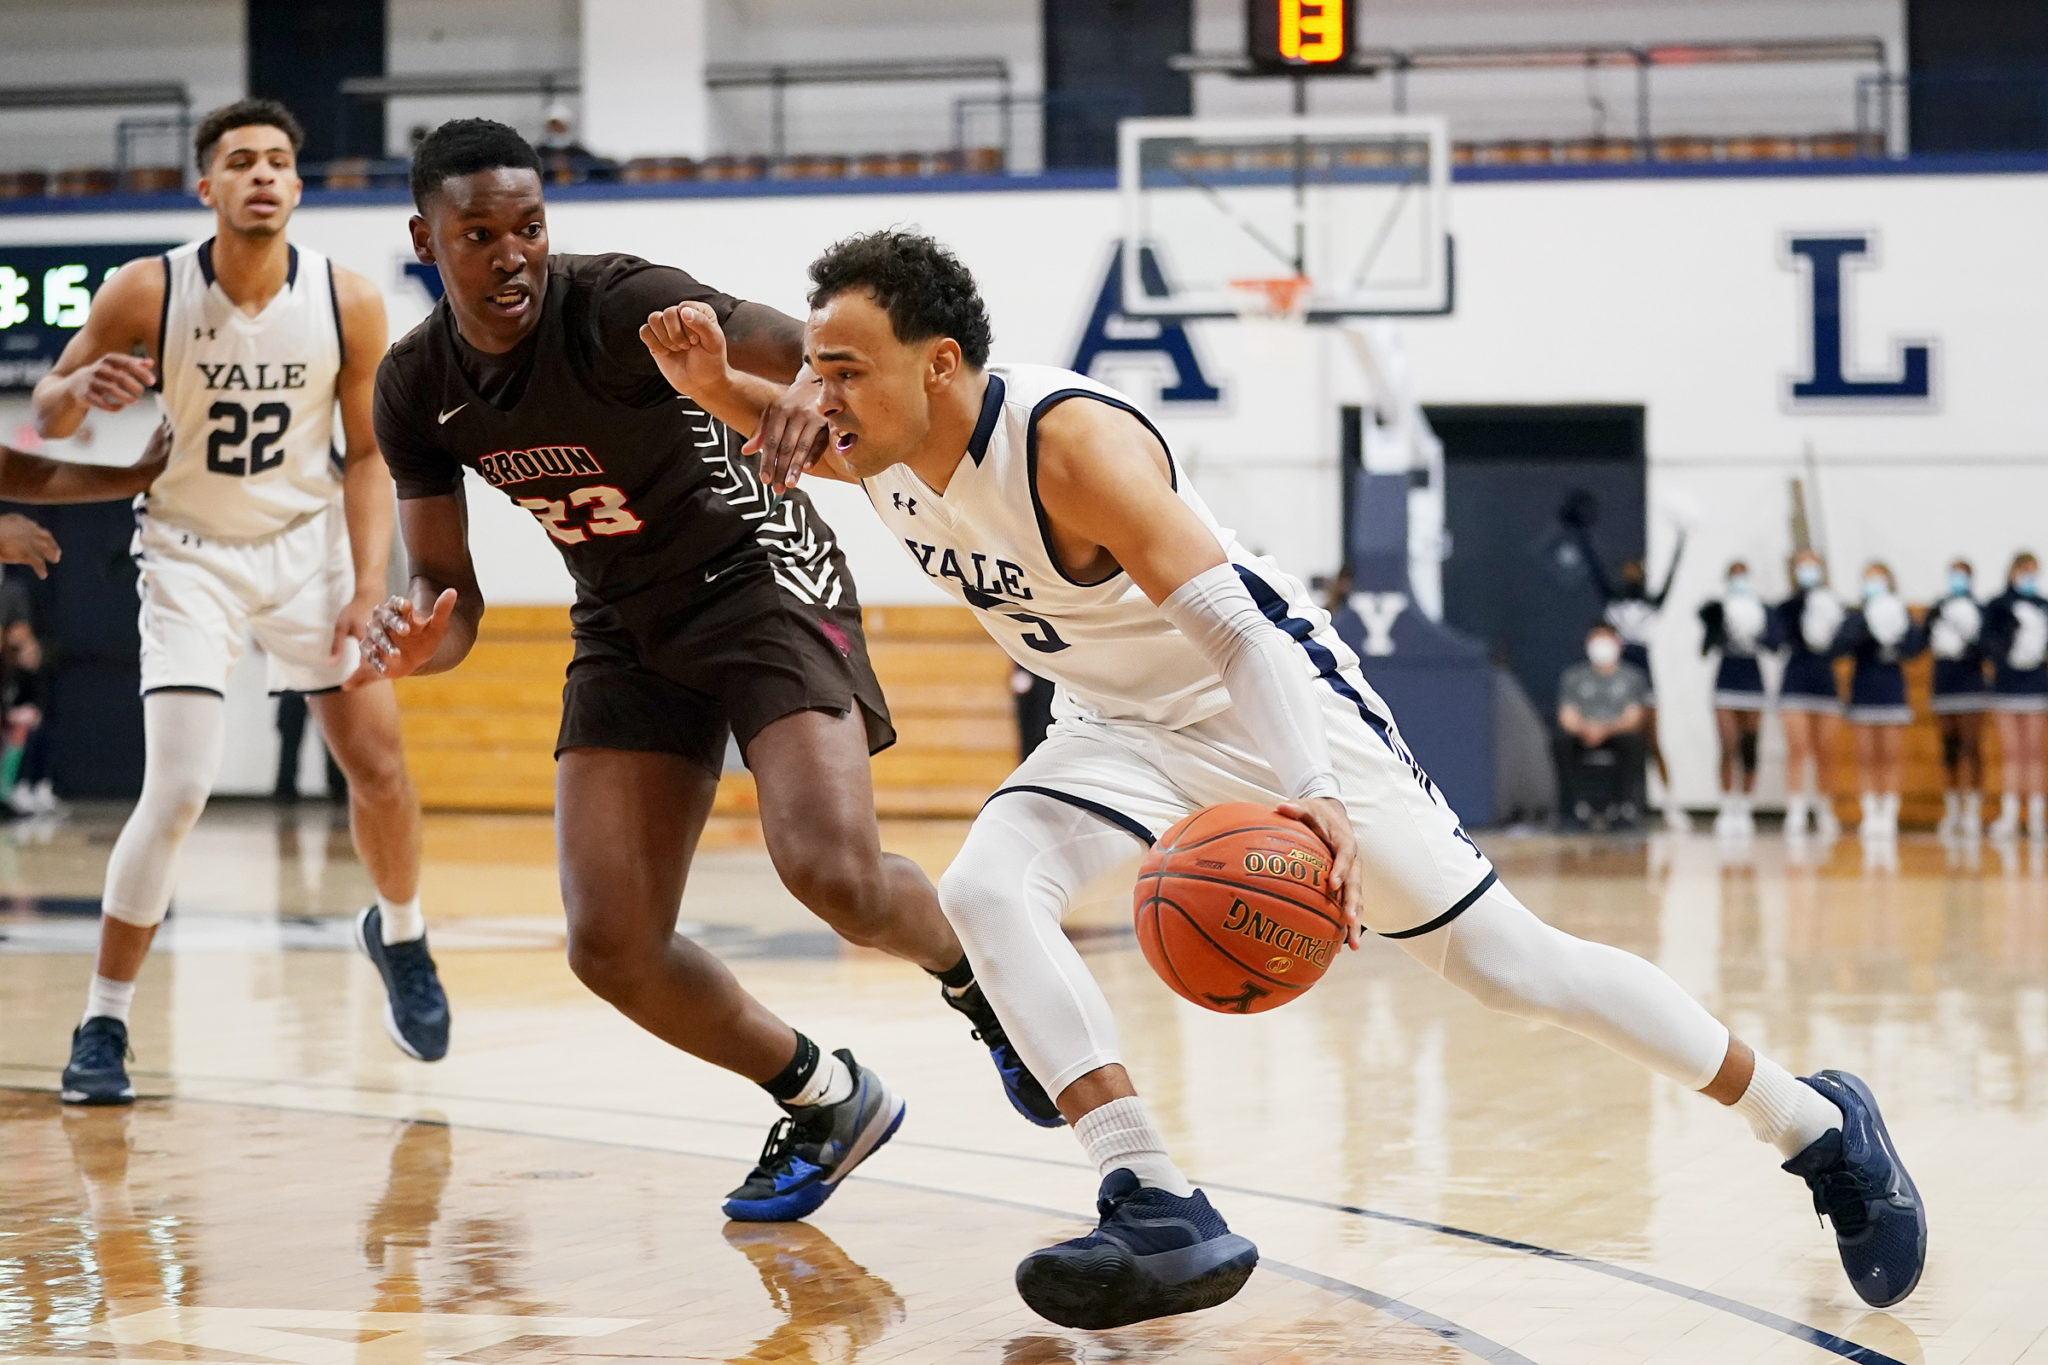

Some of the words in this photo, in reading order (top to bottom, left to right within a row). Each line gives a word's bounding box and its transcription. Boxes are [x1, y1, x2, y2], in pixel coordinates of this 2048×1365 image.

[1279, 0, 1344, 62] 13
[1786, 233, 1934, 402] L
[197, 364, 307, 390] YALE
[207, 401, 291, 477] 22
[478, 446, 606, 487] BROWN
[515, 484, 645, 546] 23
[905, 538, 1033, 600] YALE
[1347, 591, 1408, 656] Y
